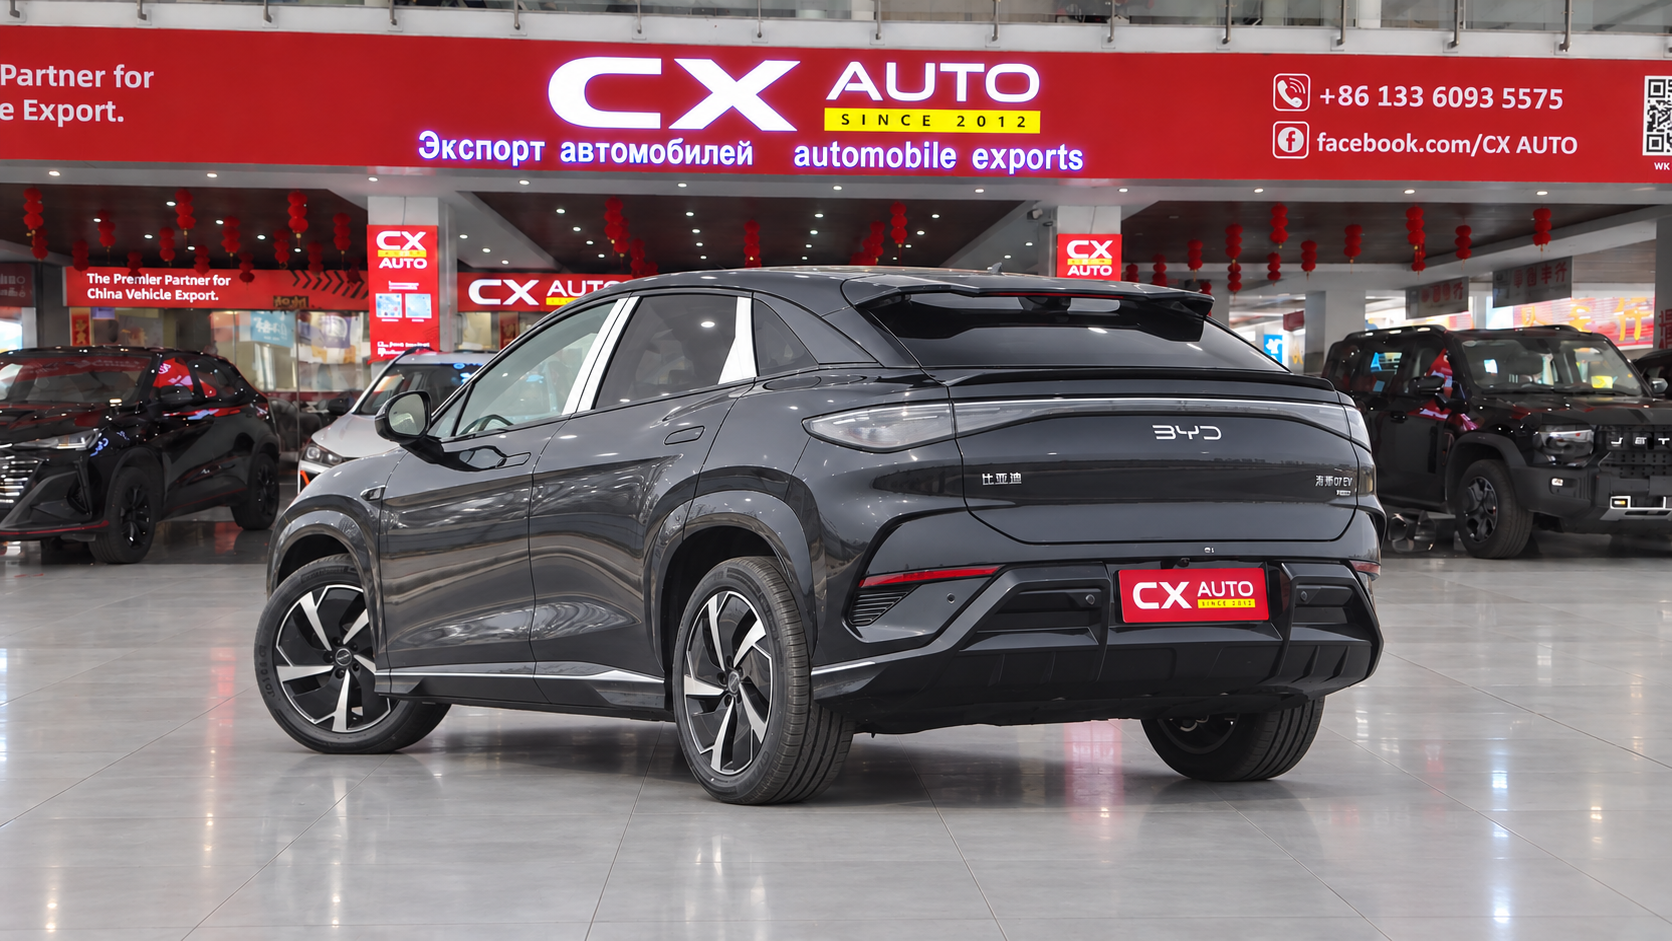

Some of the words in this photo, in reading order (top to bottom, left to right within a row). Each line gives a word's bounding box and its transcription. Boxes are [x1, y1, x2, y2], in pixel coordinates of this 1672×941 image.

[0, 64, 106, 87] Partner
[113, 64, 155, 88] for
[826, 61, 1040, 102] AUTO
[548, 57, 801, 131] CX
[1320, 85, 1369, 107] +86
[1377, 86, 1424, 108] 133
[1432, 86, 1495, 109] 6093
[1502, 87, 1564, 110] 5575
[23, 99, 125, 127] Export.
[841, 113, 931, 127] SINCE
[957, 115, 1026, 128] 2012
[418, 130, 545, 167] Экспорт
[560, 138, 753, 166] автомобилей
[1317, 133, 1511, 157] facebook.com/CX
[1516, 135, 1578, 155] AUTO
[794, 141, 957, 170] automobile
[972, 144, 1084, 175] exports
[376, 231, 427, 250] CX
[1066, 239, 1113, 259] CX
[378, 257, 428, 269] AUTO
[1067, 265, 1113, 276] AUTO
[86, 273, 111, 285] The
[113, 273, 162, 286] Premier
[164, 274, 211, 287] Partner
[212, 274, 232, 287] for
[546, 280, 628, 297] AUT
[86, 287, 123, 300] China
[125, 288, 172, 301] Vehicle
[175, 289, 220, 303] Export.
[468, 278, 540, 306] CX
[1152, 424, 1222, 440] BYD
[982, 471, 1022, 486] 比亚迪
[1132, 581, 1192, 610] CX
[1197, 581, 1253, 597] AUTO
